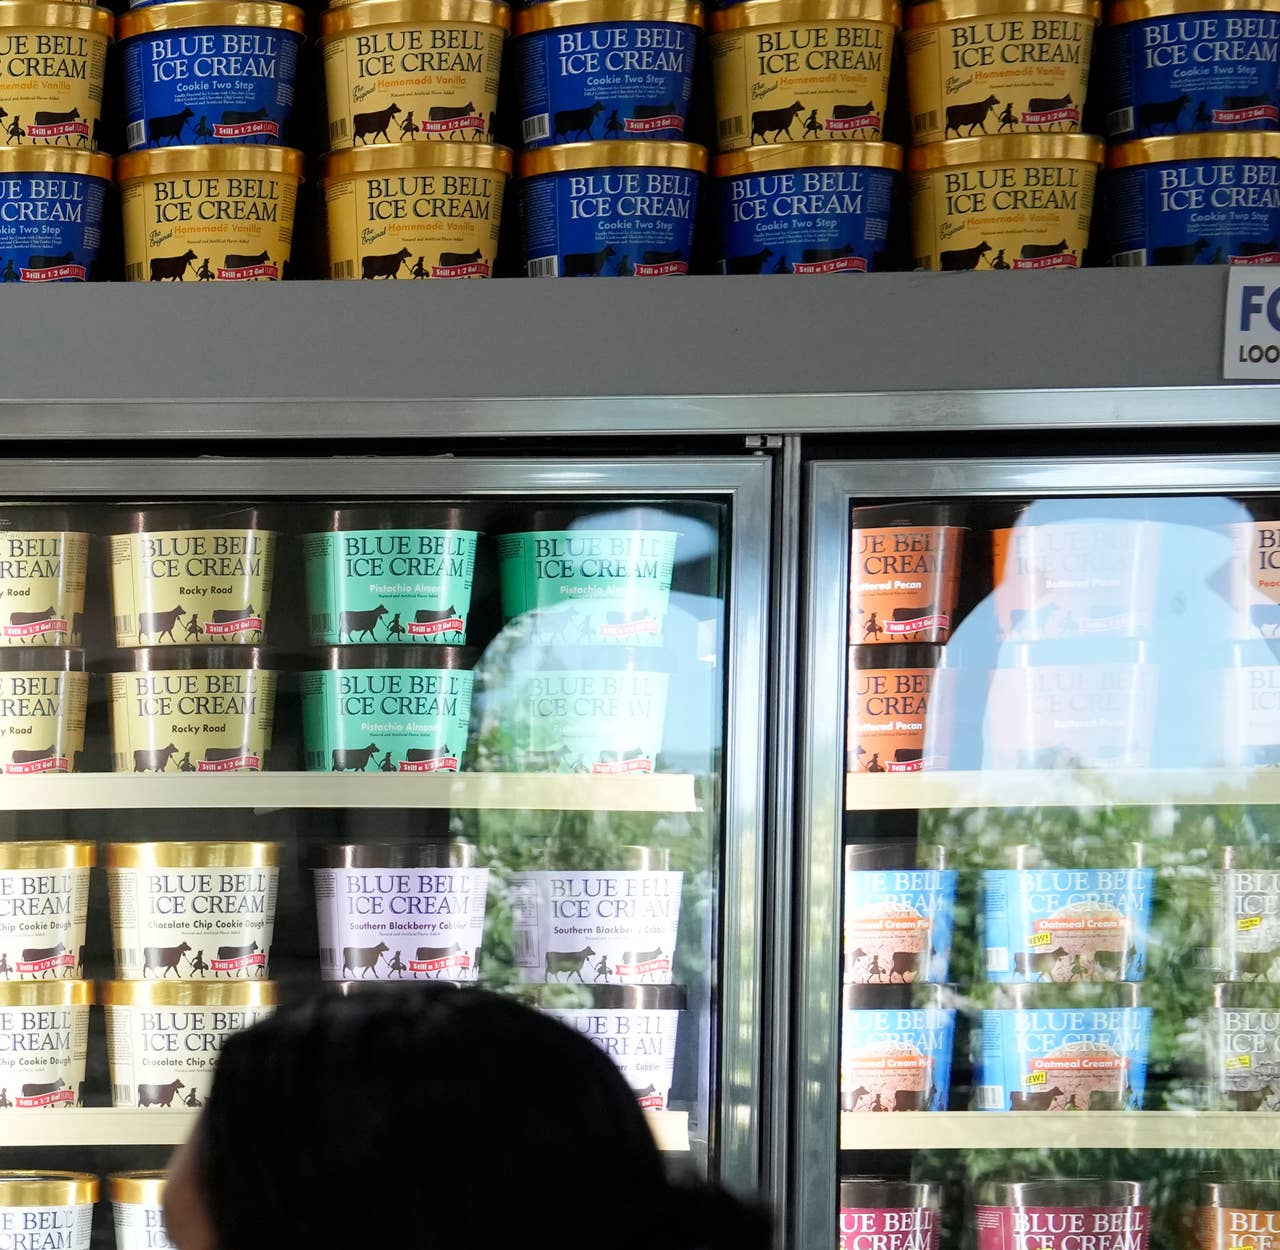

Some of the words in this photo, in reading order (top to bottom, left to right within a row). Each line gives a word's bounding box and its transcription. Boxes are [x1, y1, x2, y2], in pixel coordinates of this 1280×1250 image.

[36, 35, 88, 57] BELL
[7, 57, 87, 79] CREAM
[42, 81, 71, 90] Vanilla
[945, 169, 1016, 193] BLUE
[1024, 168, 1079, 191] BELL
[947, 193, 986, 215] ICE
[992, 190, 1078, 210] CREAM
[179, 585, 207, 597] Rocky
[210, 585, 233, 595] Road
[370, 584, 412, 593] Pistachio
[193, 920, 212, 930] Chip
[215, 920, 243, 929] Cookie
[350, 921, 386, 930] Southern
[389, 922, 436, 933] Blackberry
[1040, 920, 1084, 928] Oatmeal
[1013, 1213, 1084, 1233] BLUE
[1092, 1212, 1143, 1232] BELL
